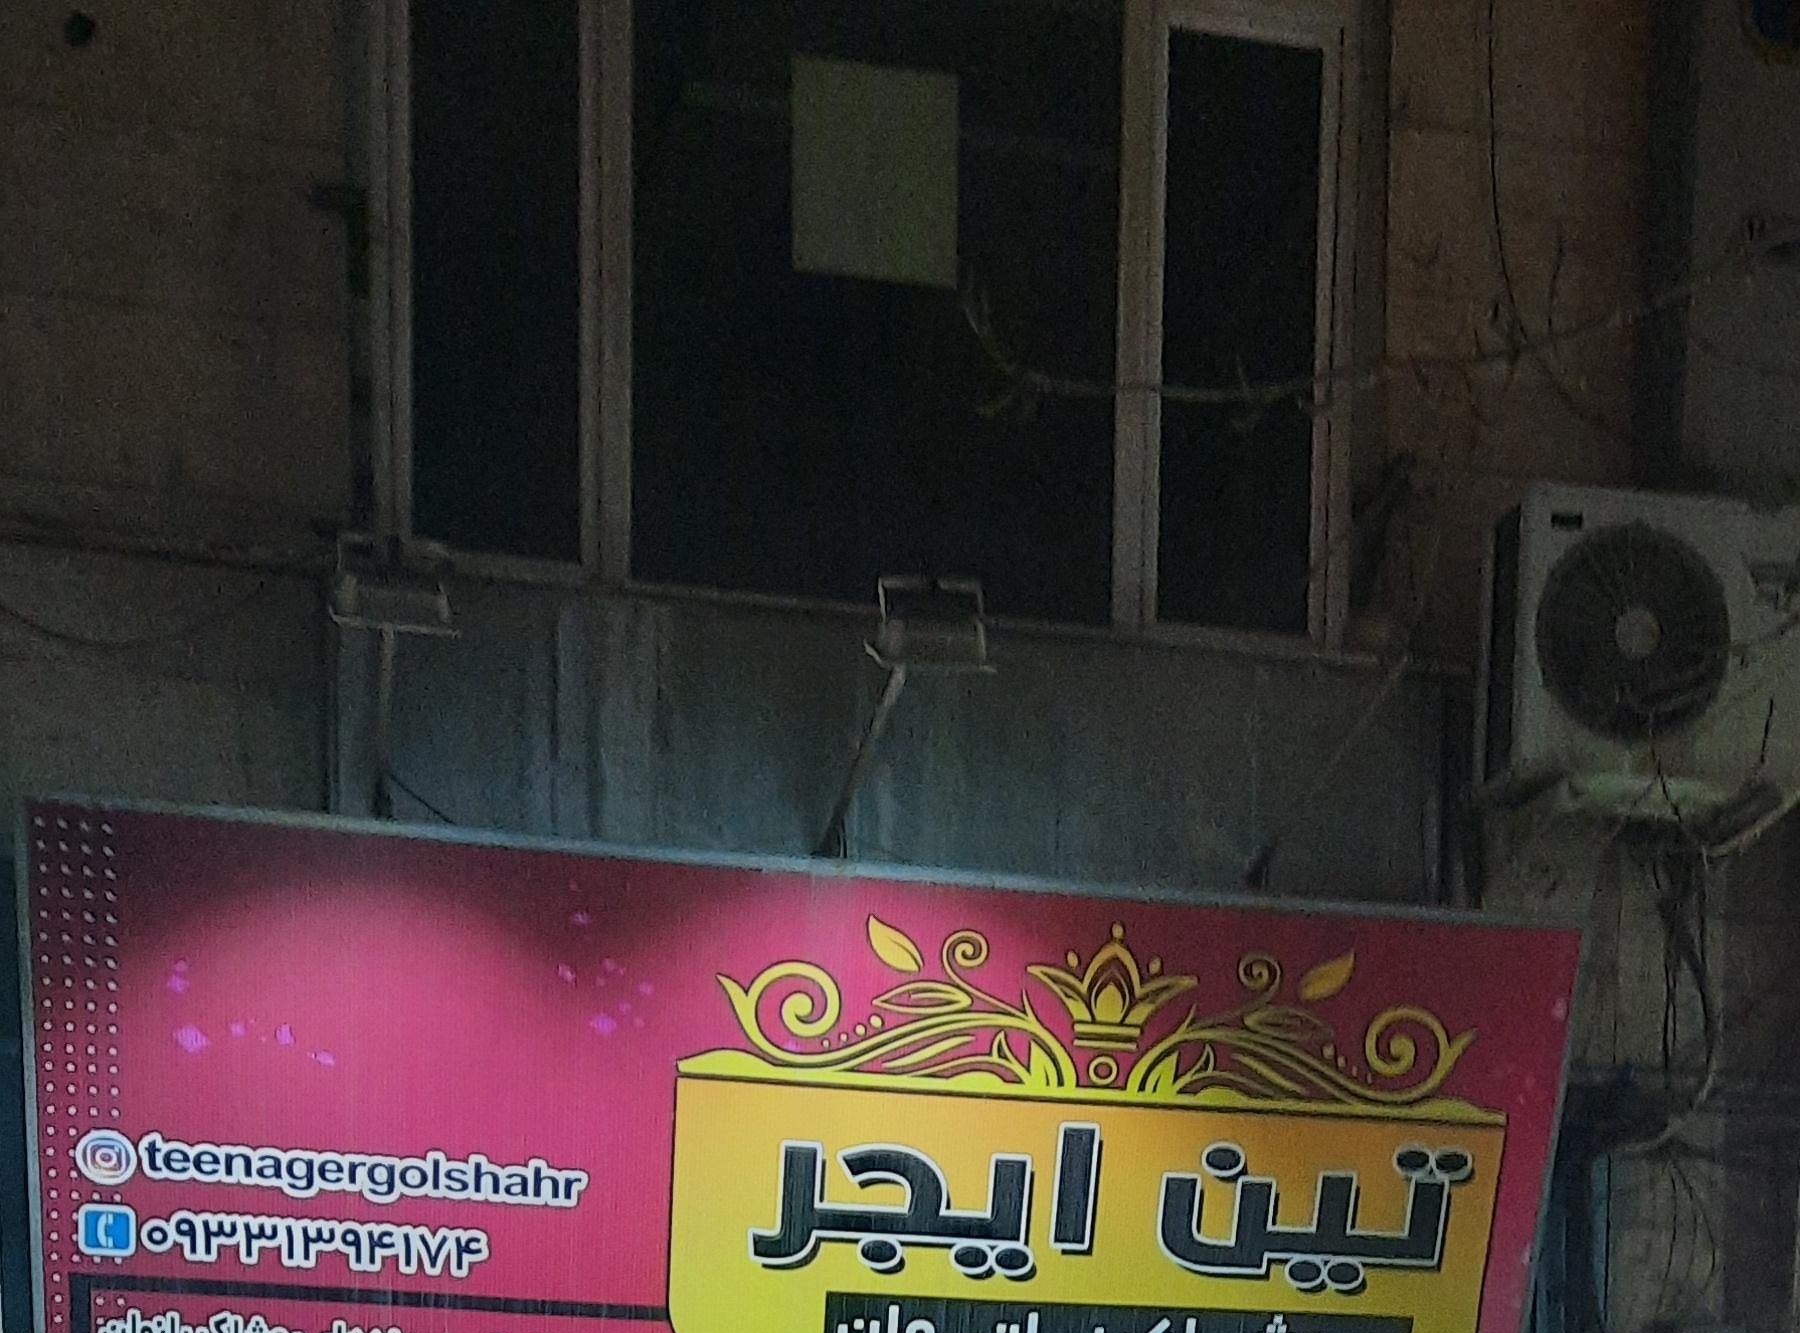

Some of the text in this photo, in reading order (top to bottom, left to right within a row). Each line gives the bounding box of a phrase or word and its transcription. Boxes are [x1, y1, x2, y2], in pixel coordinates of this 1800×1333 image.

[143, 1138, 582, 1201] teenagergolshahr
[748, 1122, 1470, 1292] تین ایجر
[145, 1215, 484, 1272] ۰۹۳۳۱۳۹۴۱۷۴
